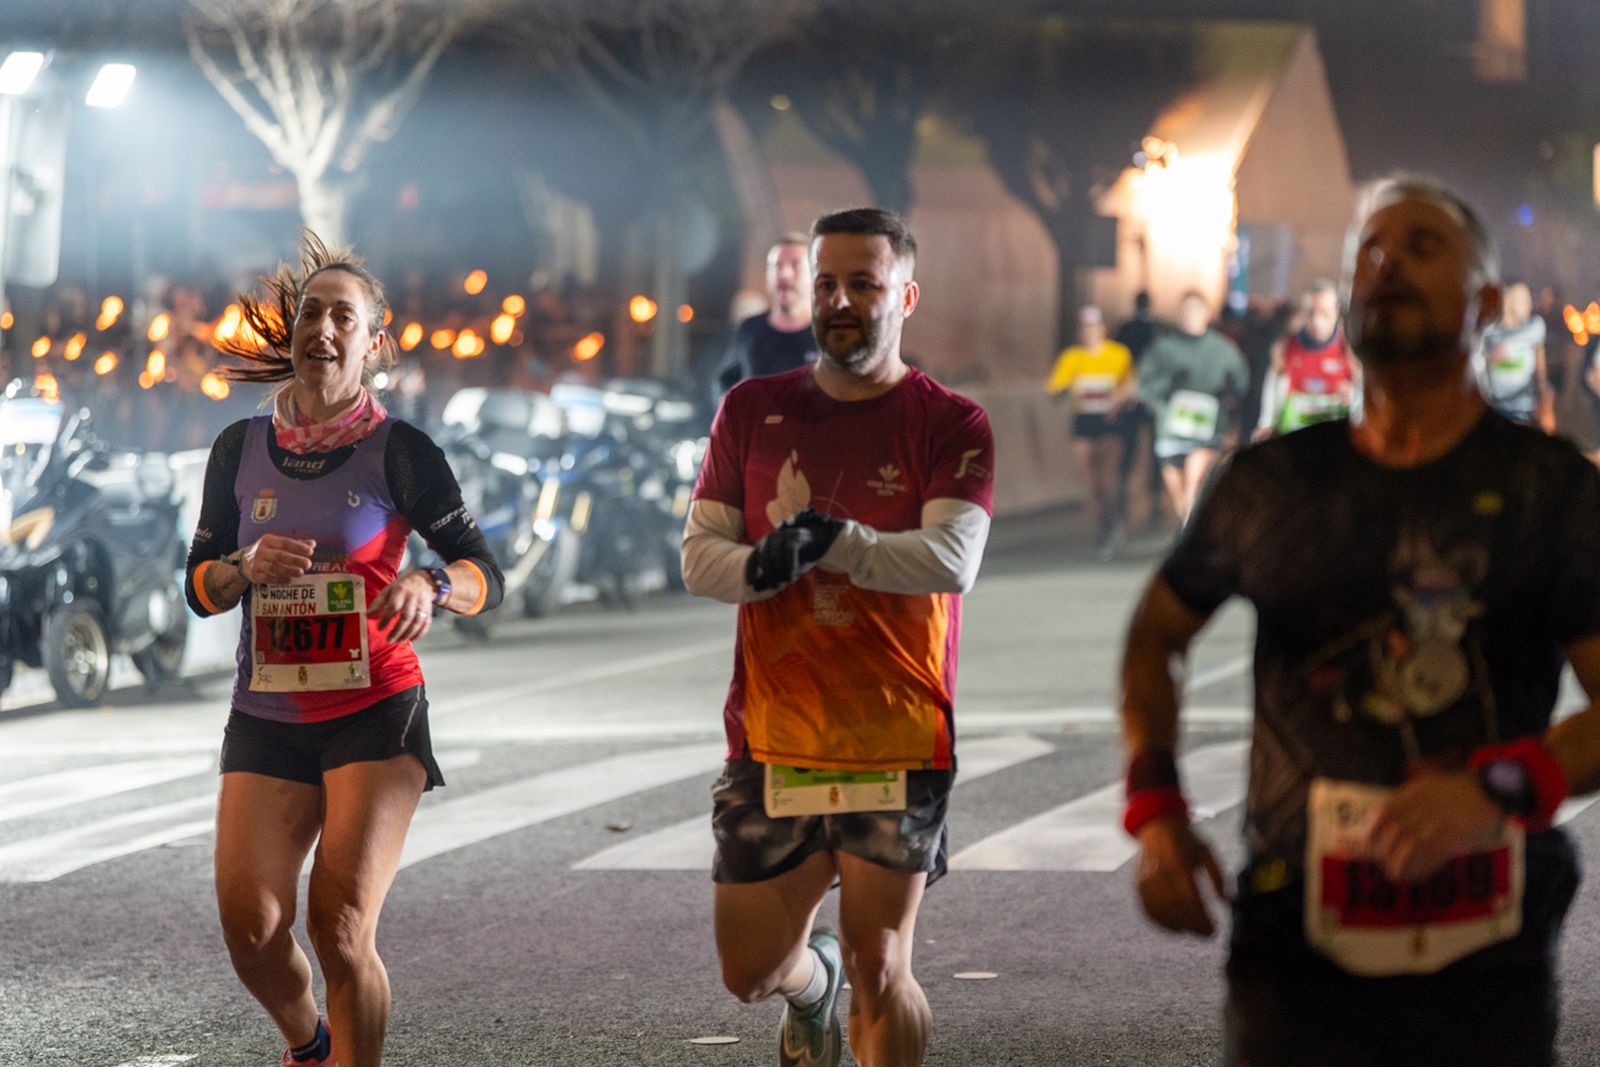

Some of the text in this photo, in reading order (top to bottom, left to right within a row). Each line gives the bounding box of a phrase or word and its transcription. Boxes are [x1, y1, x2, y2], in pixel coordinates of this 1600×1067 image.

[282, 456, 326, 470] land
[270, 588, 316, 600] NOCHE DE
[262, 603, 279, 616] SAN
[279, 599, 317, 615] ANTÓN
[267, 616, 345, 652] 12677
